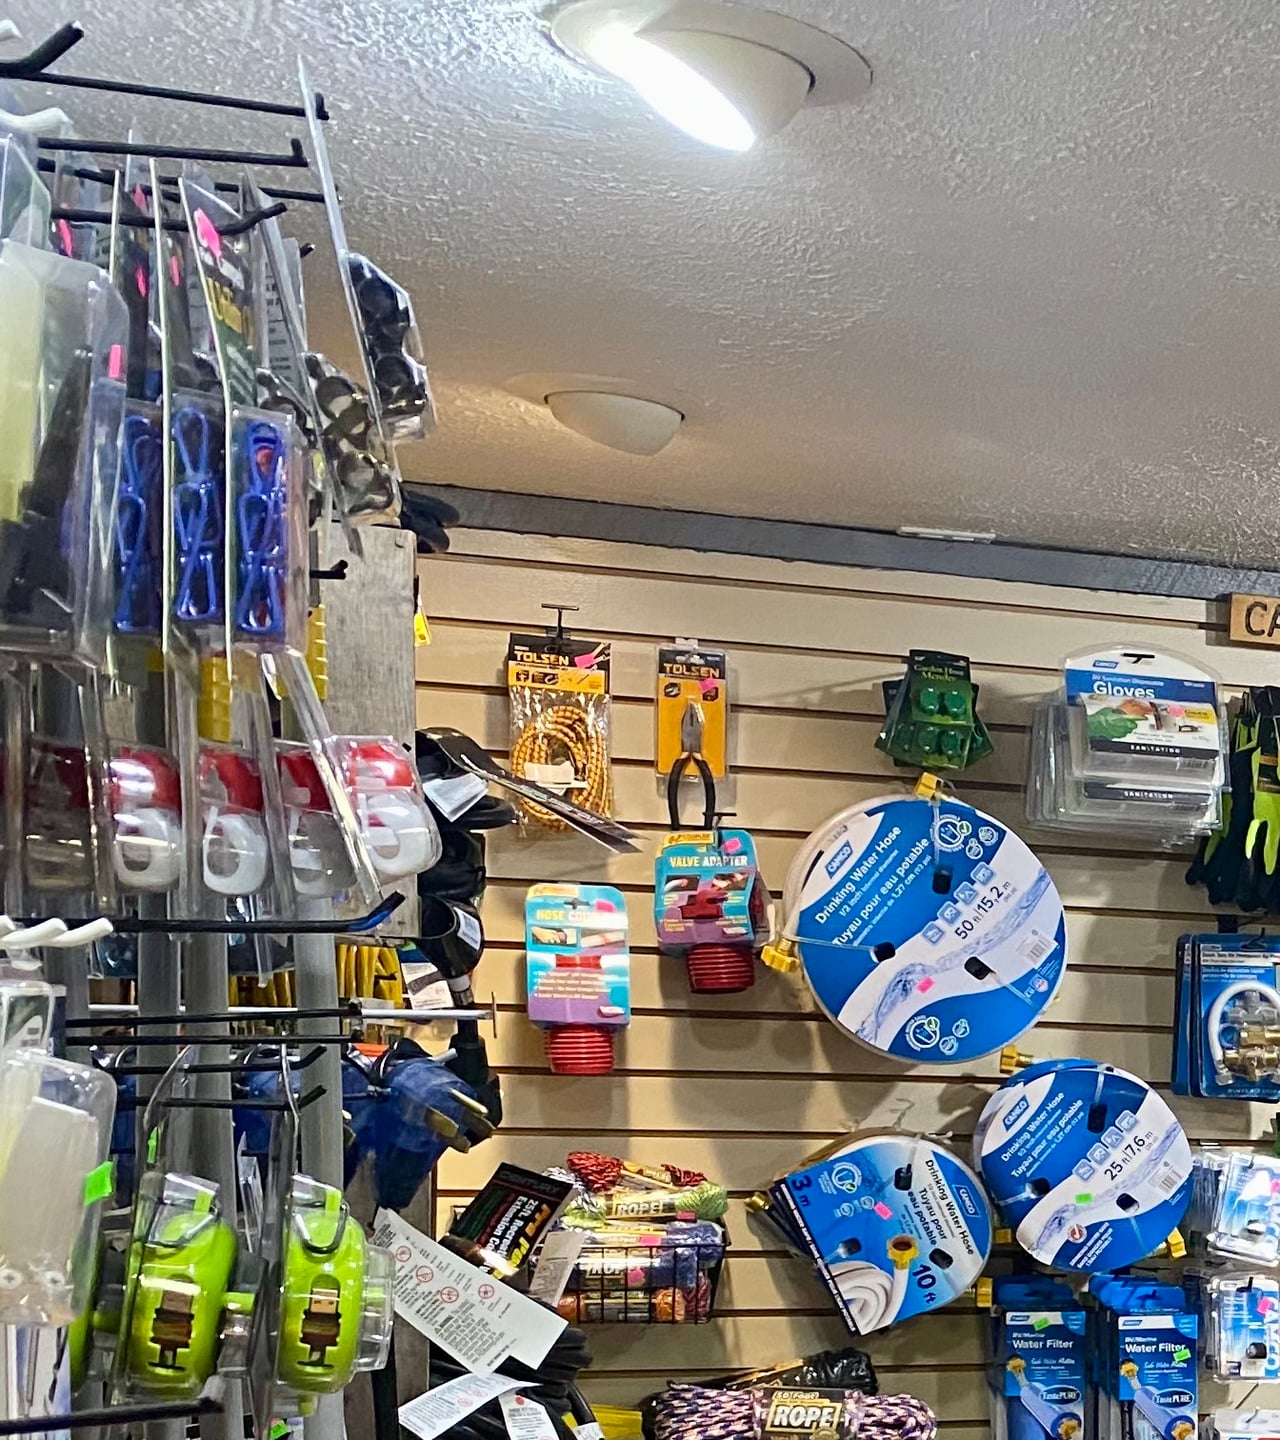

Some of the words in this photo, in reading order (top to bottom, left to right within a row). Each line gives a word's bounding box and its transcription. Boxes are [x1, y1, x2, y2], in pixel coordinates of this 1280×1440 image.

[515, 651, 569, 666] TOLSEN
[663, 663, 720, 678] TOLSEN
[1093, 681, 1155, 699] Gloves
[669, 856, 700, 868] VALVE
[880, 874, 900, 898] eau
[896, 836, 930, 878] potable
[814, 882, 856, 925] Drinking
[852, 854, 880, 886] Water
[877, 826, 902, 858] Hose
[1045, 1124, 1060, 1141] eau
[907, 1191, 920, 1209] eau
[919, 1188, 935, 1217] Tuyau
[932, 1217, 948, 1241] pour
[960, 1229, 974, 1255] Hose
[1012, 1340, 1044, 1349] Water
[1046, 1339, 1073, 1349] Filter
[1125, 1343, 1157, 1353] Water
[1158, 1342, 1186, 1352] Filter
[773, 1404, 835, 1428] ROPE
